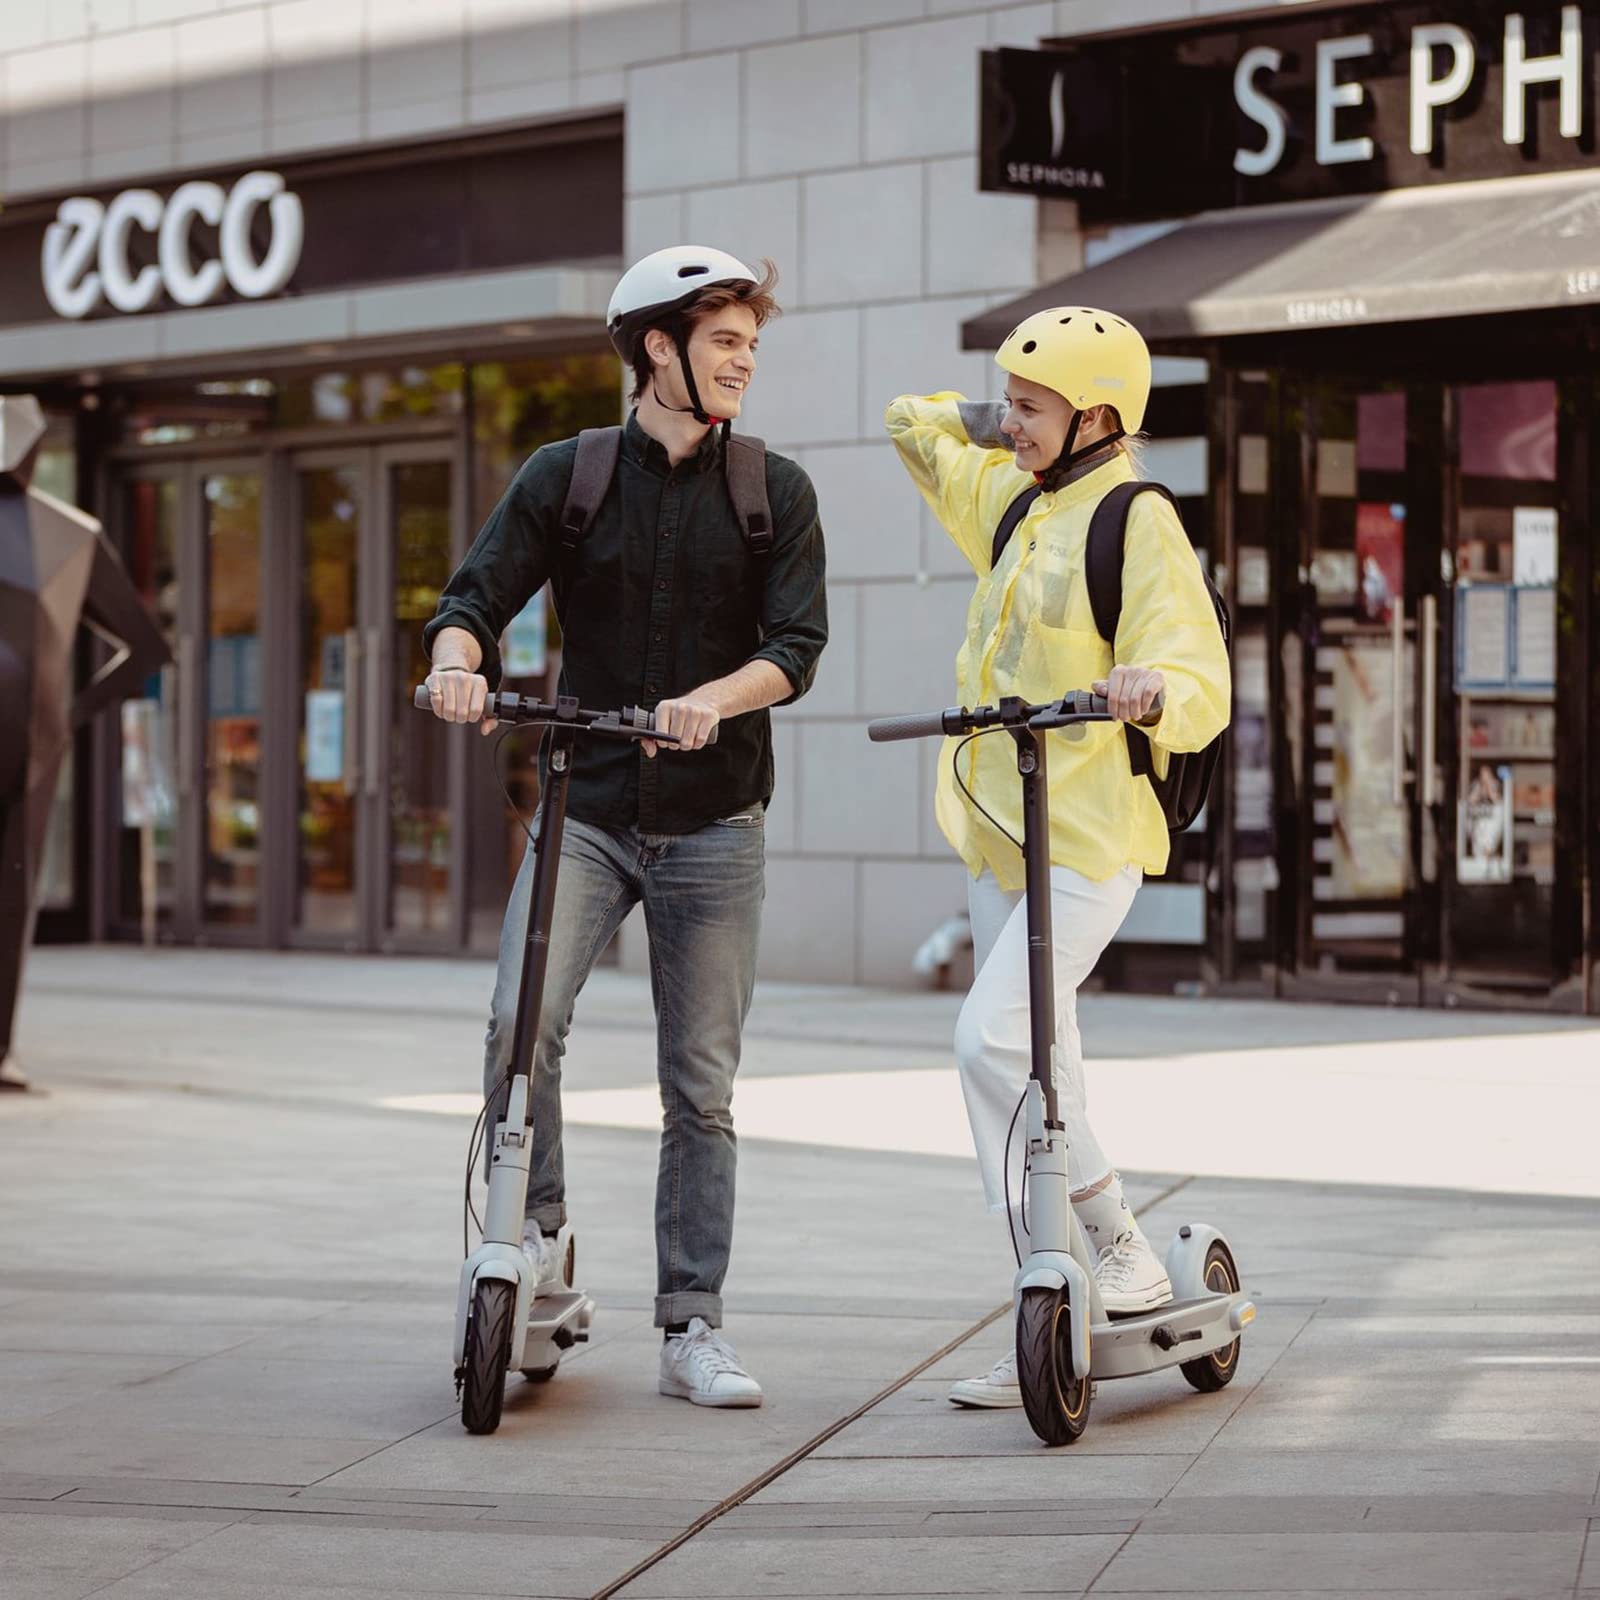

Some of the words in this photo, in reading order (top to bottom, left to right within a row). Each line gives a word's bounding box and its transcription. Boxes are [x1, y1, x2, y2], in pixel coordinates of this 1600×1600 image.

[1233, 5, 1582, 176] SEPH
[1007, 161, 1104, 189] SEPHORA
[41, 170, 304, 318] ecco
[1286, 298, 1367, 324] SEPHORA
